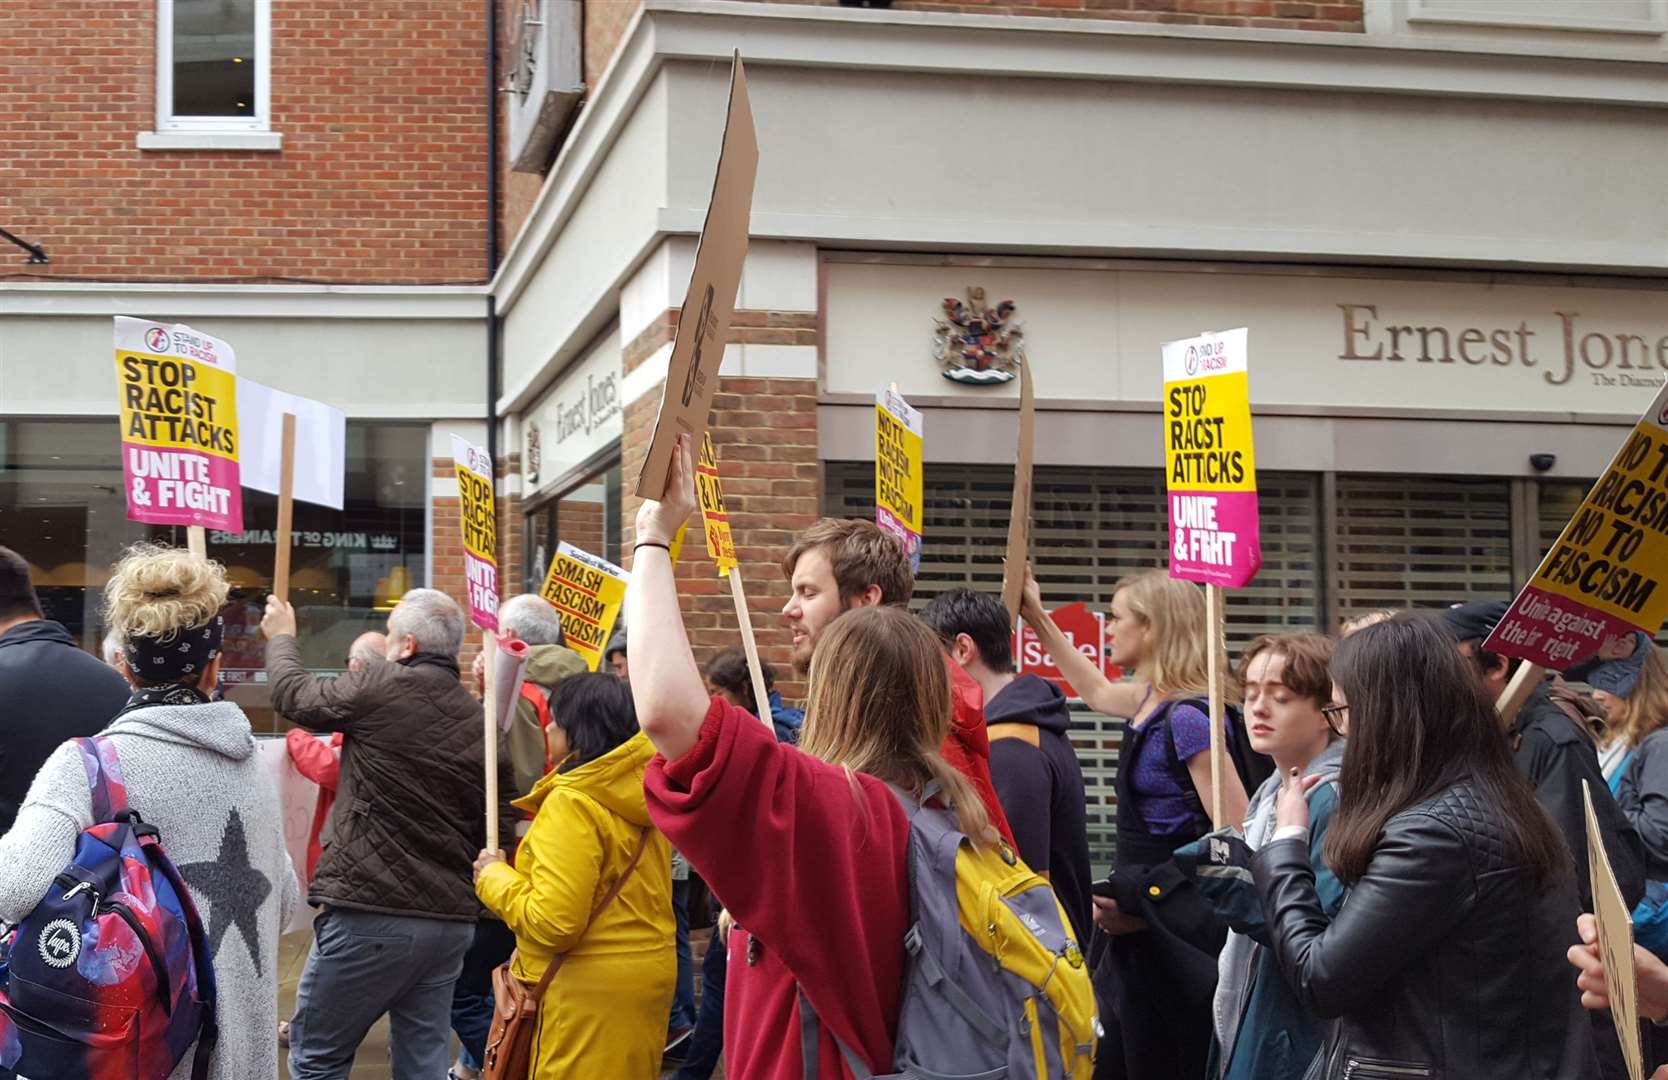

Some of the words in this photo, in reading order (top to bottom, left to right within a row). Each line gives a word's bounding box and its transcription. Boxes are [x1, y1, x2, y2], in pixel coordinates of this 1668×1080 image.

[173, 342, 188, 354] TO
[1336, 303, 1538, 368] Ernest
[123, 356, 196, 388] STOP
[126, 383, 217, 423] RACIST
[128, 411, 234, 455] ATTACKS
[1171, 417, 1224, 450] RACST
[129, 447, 211, 485] UNITE
[1172, 451, 1244, 484] ATTCKS
[1616, 430, 1652, 471] NO
[1649, 443, 1668, 488] T
[131, 477, 152, 507] &
[158, 480, 231, 516] FIGHT
[459, 469, 491, 506] STOP
[463, 495, 496, 533] RACIS
[464, 521, 496, 560] ATTA
[1174, 528, 1188, 561] &
[1566, 508, 1605, 547] NO
[1603, 518, 1645, 563] TO
[554, 558, 603, 592] SMASH
[1541, 545, 1658, 614] FASCISM
[545, 581, 606, 620] FASCISM
[1500, 620, 1525, 645] the
[1542, 634, 1580, 661] right
[1547, 607, 1606, 640] against
[1024, 632, 1097, 668] se
